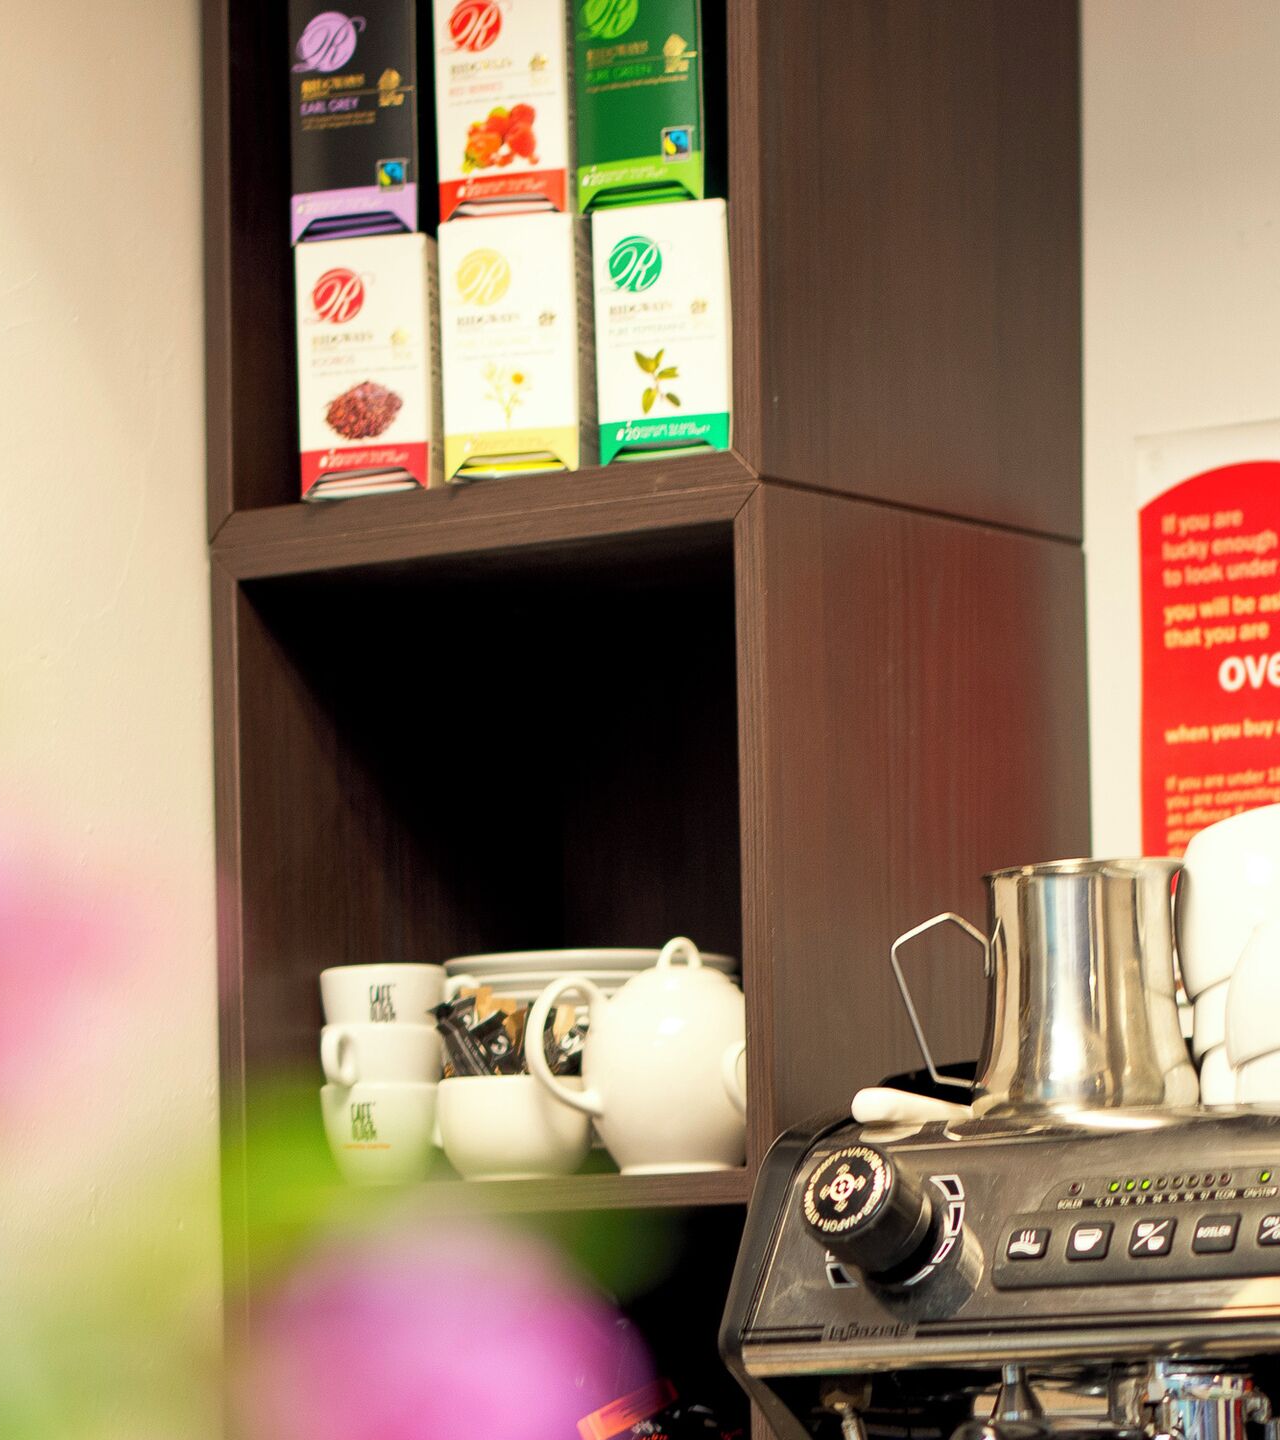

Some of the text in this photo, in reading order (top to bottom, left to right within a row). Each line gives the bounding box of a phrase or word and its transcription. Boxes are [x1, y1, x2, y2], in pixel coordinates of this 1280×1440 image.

[1162, 509, 1243, 536] If you are
[1162, 529, 1278, 561] lucky enough
[1163, 568, 1182, 588] to
[1184, 563, 1223, 585] look
[1226, 556, 1277, 581] under
[1164, 603, 1197, 625] you
[1199, 596, 1230, 618] will
[1232, 594, 1256, 615] be
[1164, 621, 1269, 649] that you are
[1165, 723, 1210, 745] when
[1212, 719, 1241, 744] you
[1243, 715, 1274, 739] buy
[1178, 777, 1201, 793] you
[1203, 773, 1225, 788] are
[1227, 768, 1265, 786] under
[1166, 793, 1214, 811] you are
[1166, 812, 1183, 827] an
[1057, 1198, 1084, 1210] BOILER
[1105, 1197, 1114, 1207] 91
[1120, 1196, 1130, 1206] 92
[1136, 1195, 1146, 1205] 93
[1152, 1194, 1163, 1204] 94
[1168, 1193, 1179, 1203] 95
[1184, 1192, 1195, 1202] 96
[1200, 1191, 1210, 1201] 97
[1196, 1225, 1232, 1239] BOILER
